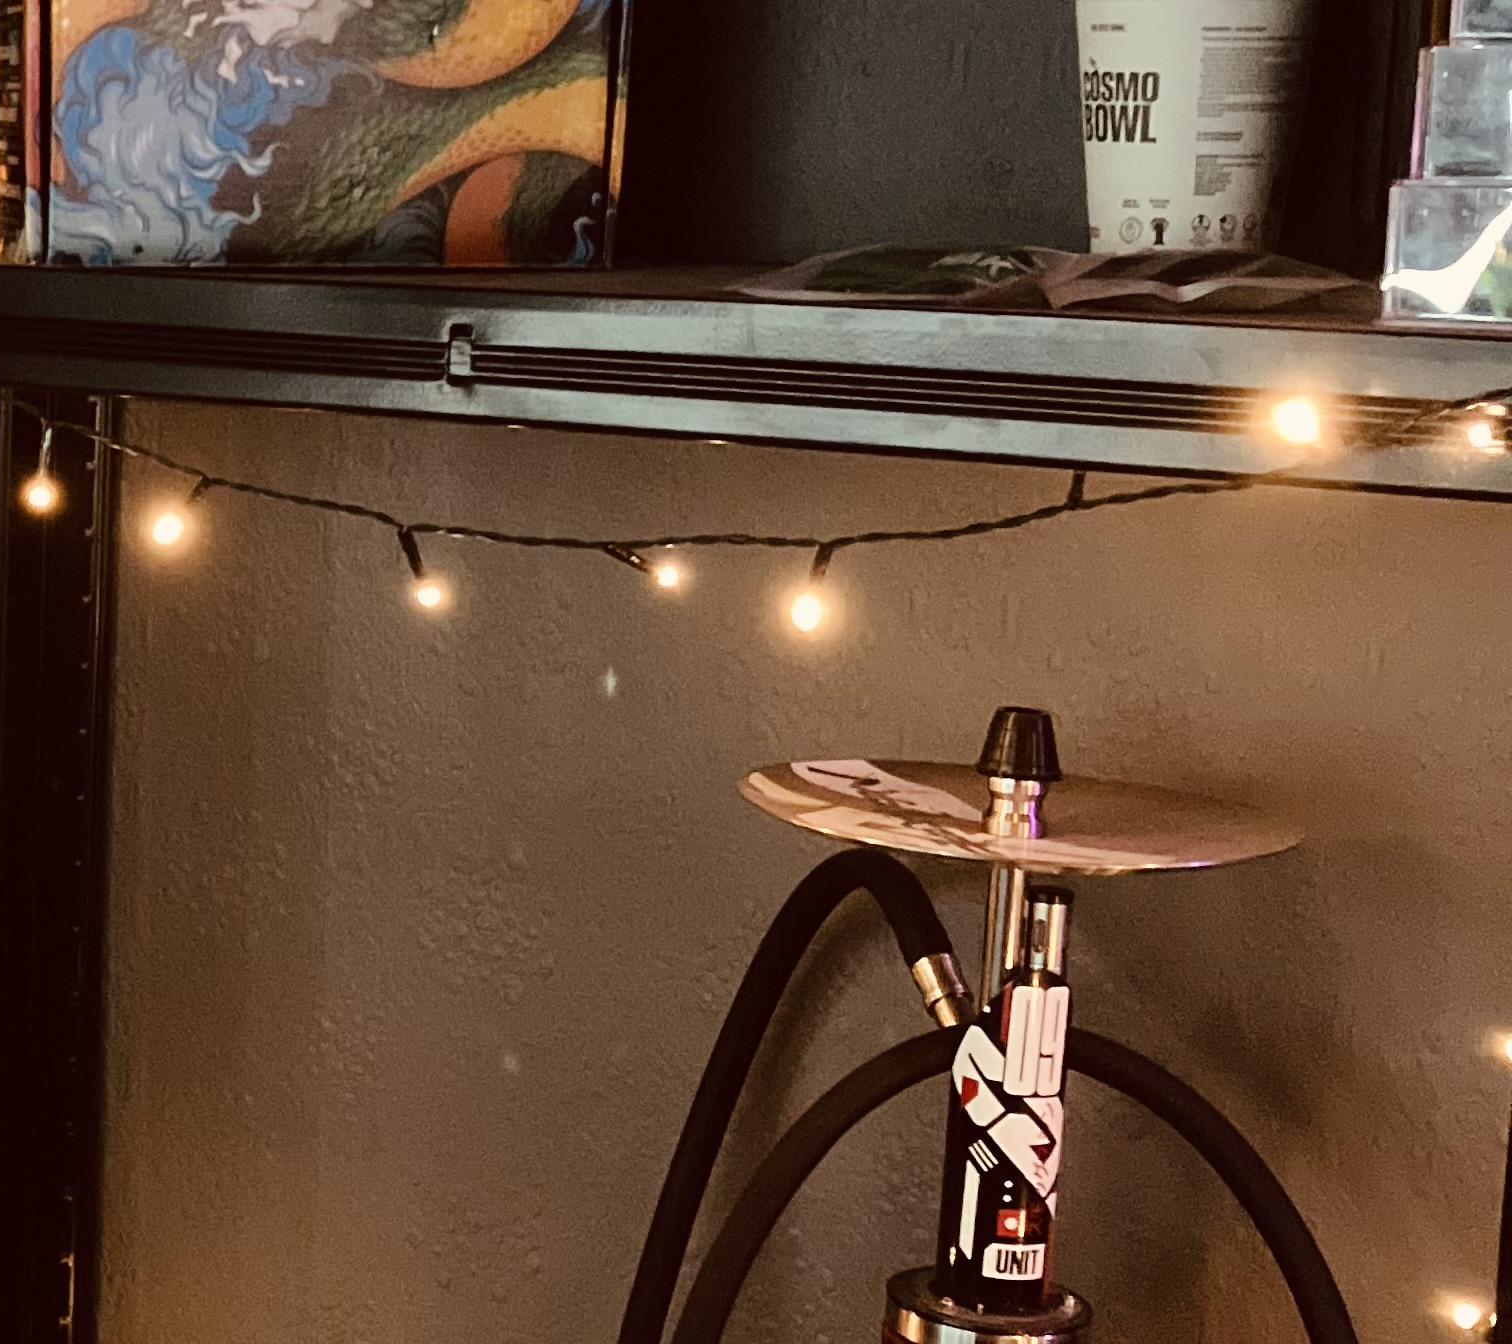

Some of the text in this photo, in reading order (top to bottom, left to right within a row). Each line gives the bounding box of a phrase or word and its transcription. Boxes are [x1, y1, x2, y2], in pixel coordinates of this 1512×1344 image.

[1083, 69, 1161, 103] COSMO
[1085, 104, 1157, 145] BOWL
[995, 1248, 1040, 1275] UNIT
